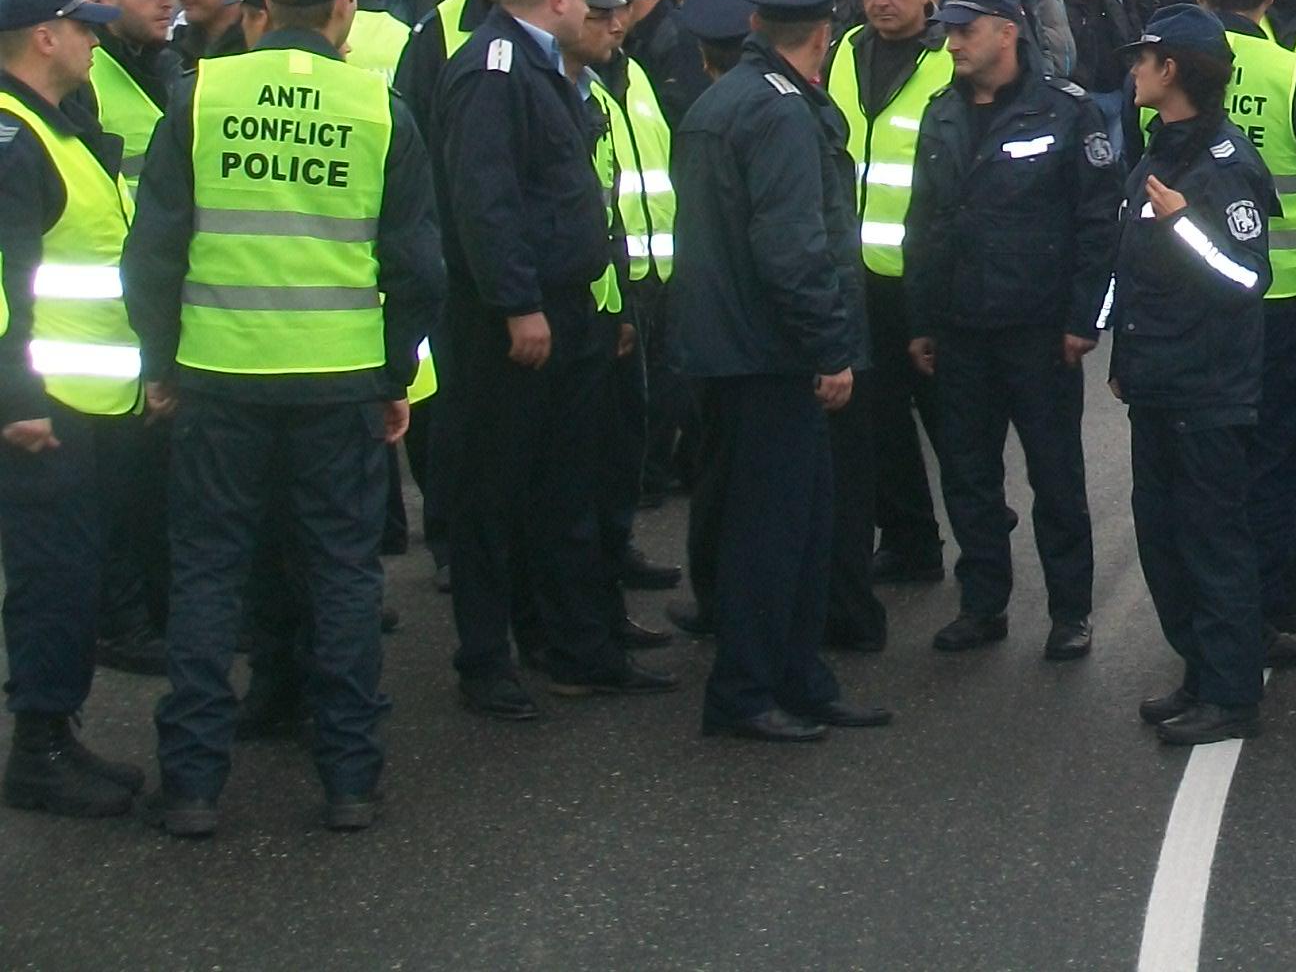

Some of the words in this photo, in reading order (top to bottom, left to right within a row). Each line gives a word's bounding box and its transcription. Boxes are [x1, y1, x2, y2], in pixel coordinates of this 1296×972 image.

[257, 84, 321, 111] ANTI
[222, 115, 353, 149] CONFLICT
[221, 151, 351, 188] POLICE
